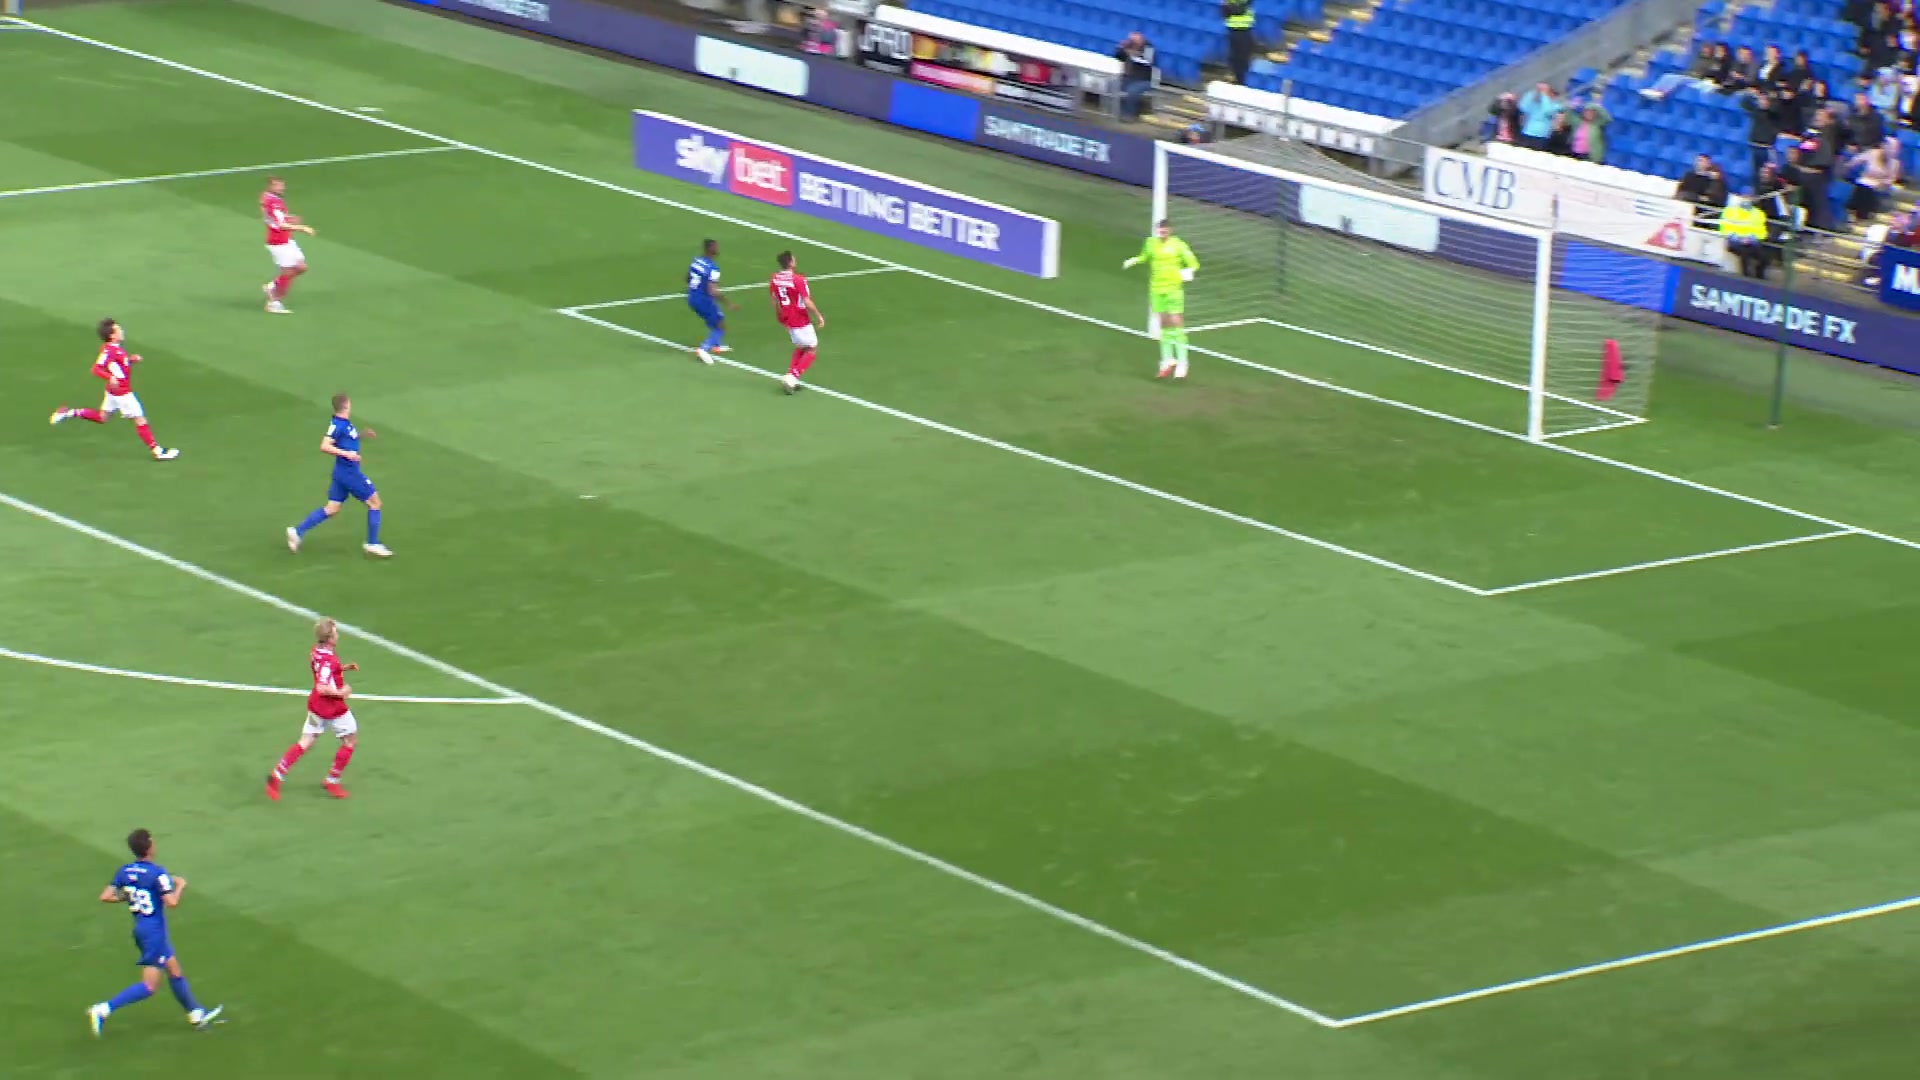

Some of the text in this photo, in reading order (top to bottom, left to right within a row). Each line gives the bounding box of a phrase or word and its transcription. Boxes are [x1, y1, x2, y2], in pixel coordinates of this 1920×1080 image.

[675, 134, 787, 192] sky bet
[1434, 156, 1516, 209] CMB
[799, 172, 1001, 252] BETTING BETTER
[1822, 315, 1858, 344] FX
